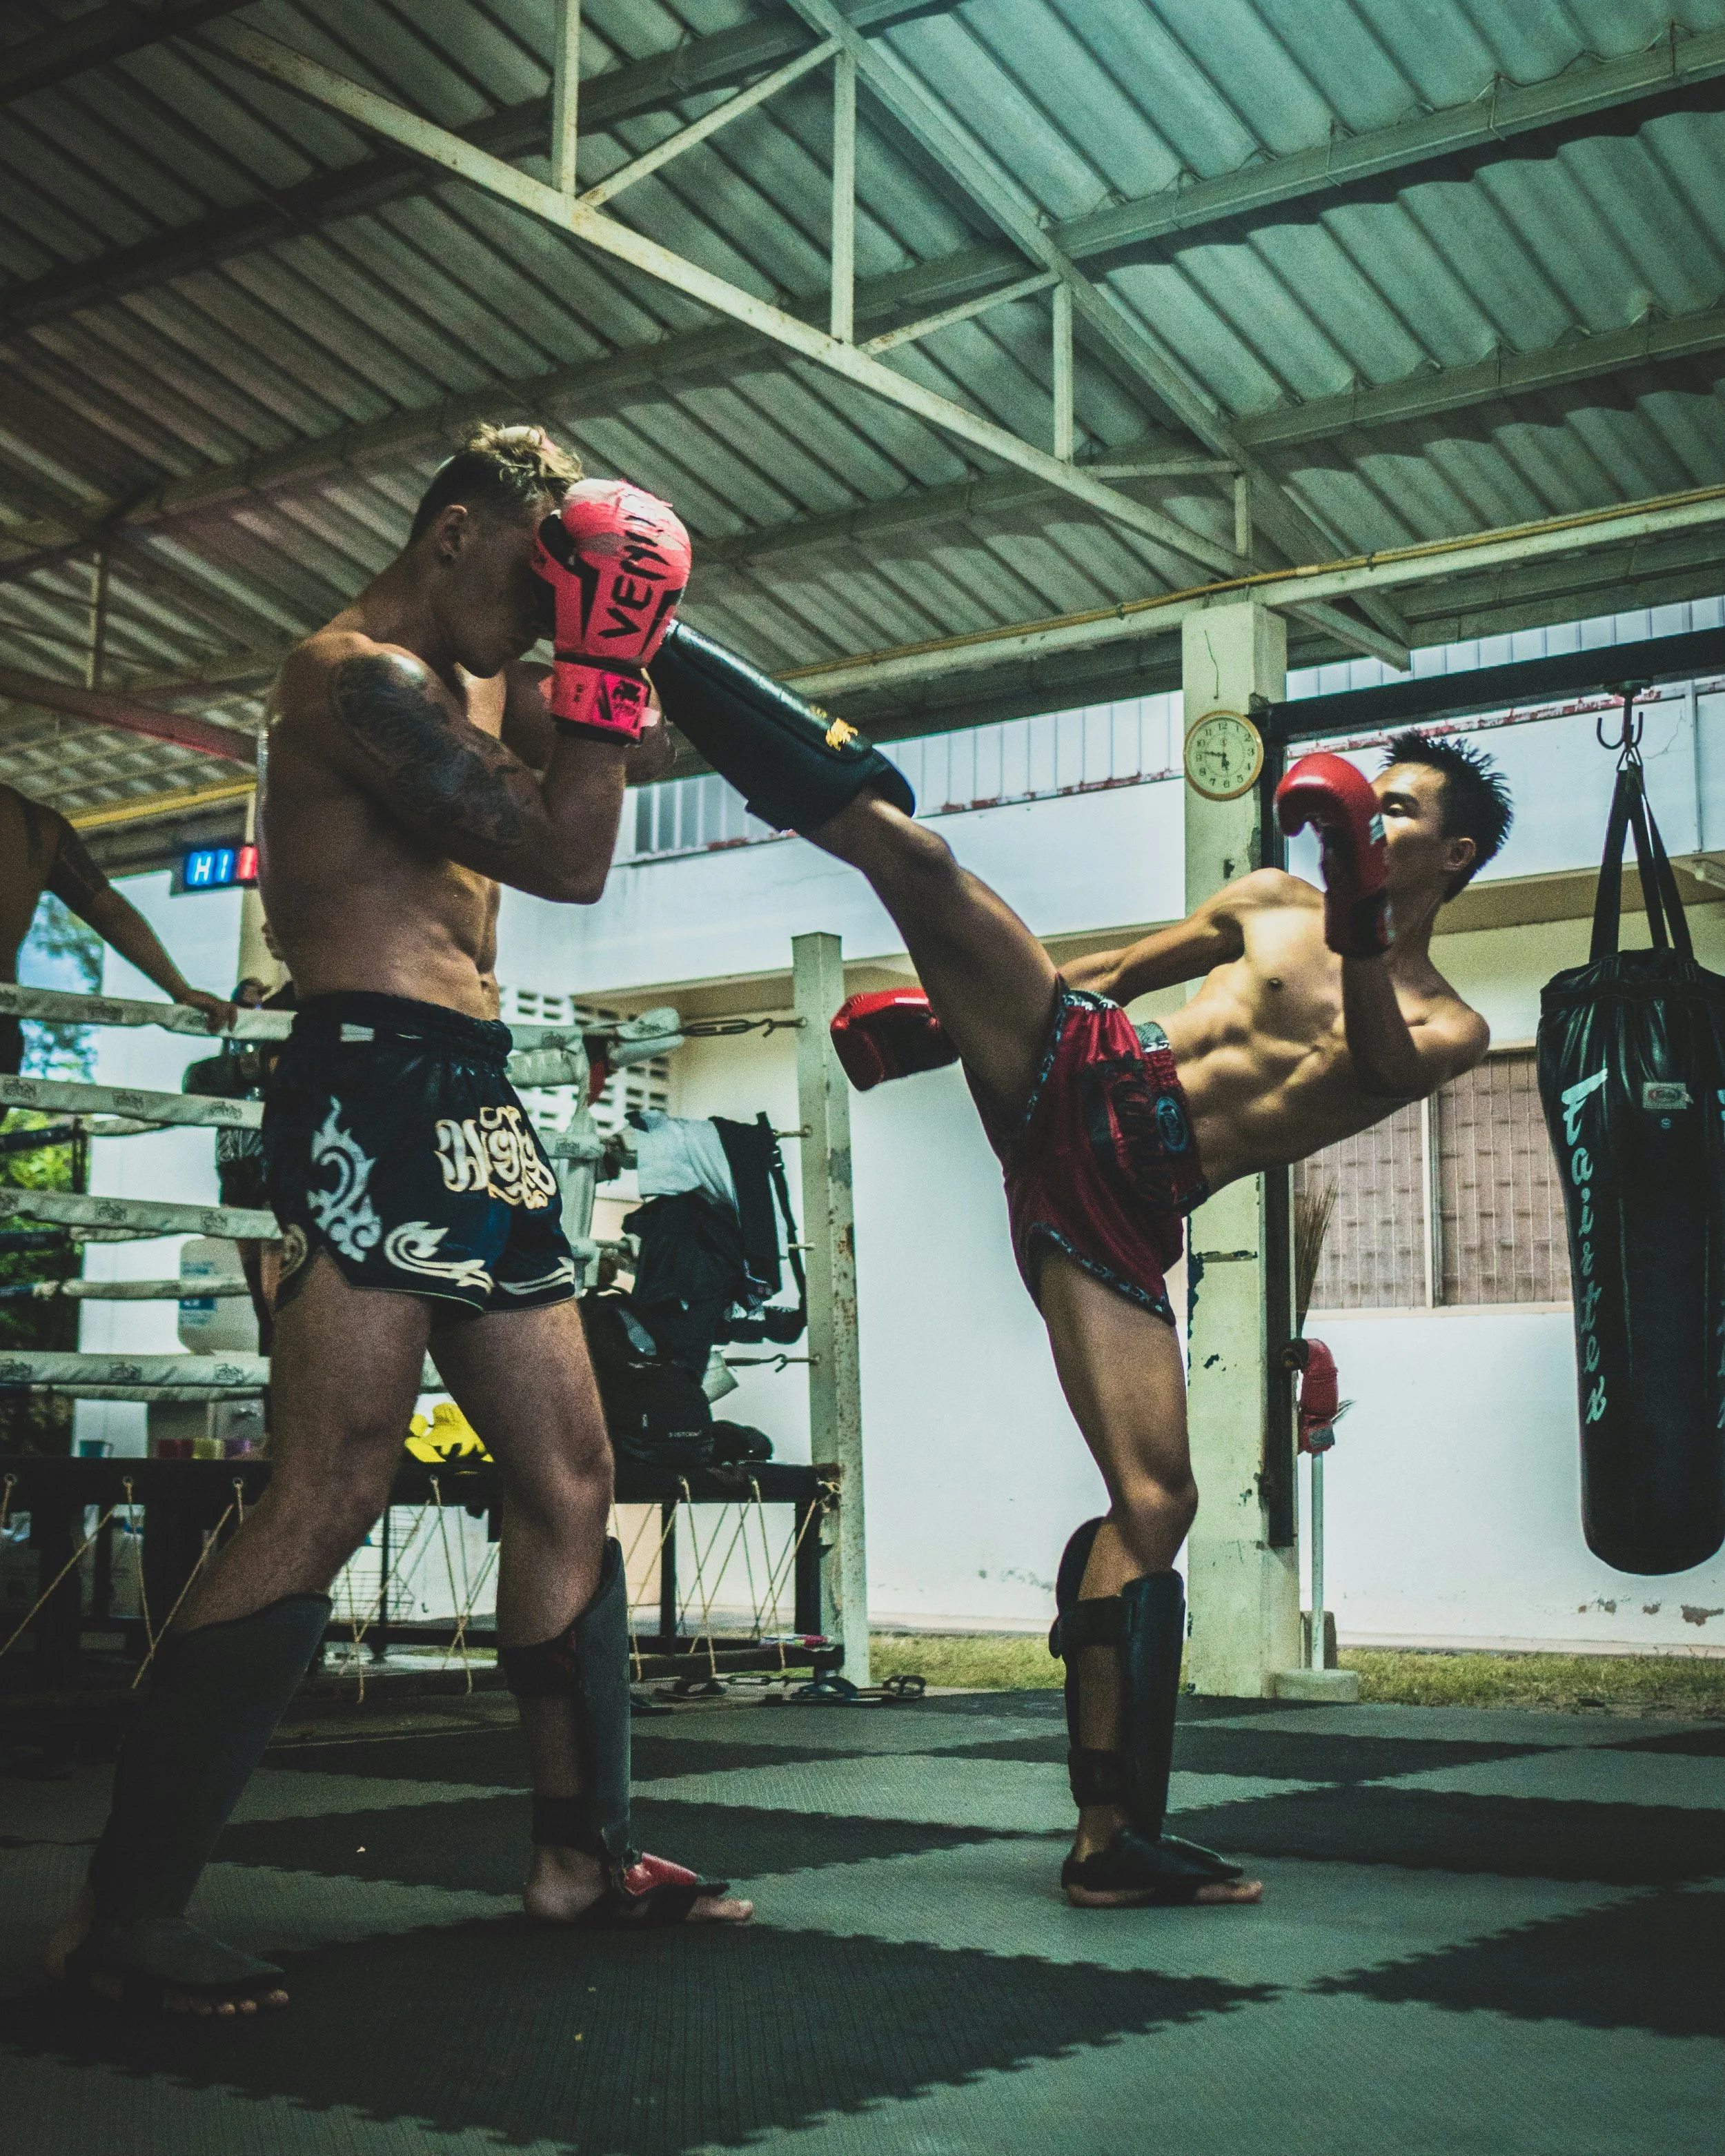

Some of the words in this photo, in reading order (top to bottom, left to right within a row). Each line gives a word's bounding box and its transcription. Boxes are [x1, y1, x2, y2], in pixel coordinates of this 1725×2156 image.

[1218, 722, 1228, 731] 12
[1245, 733, 1251, 742] 2
[1210, 778, 1216, 786] 7
[1561, 1068, 1608, 1424] Fairtex
